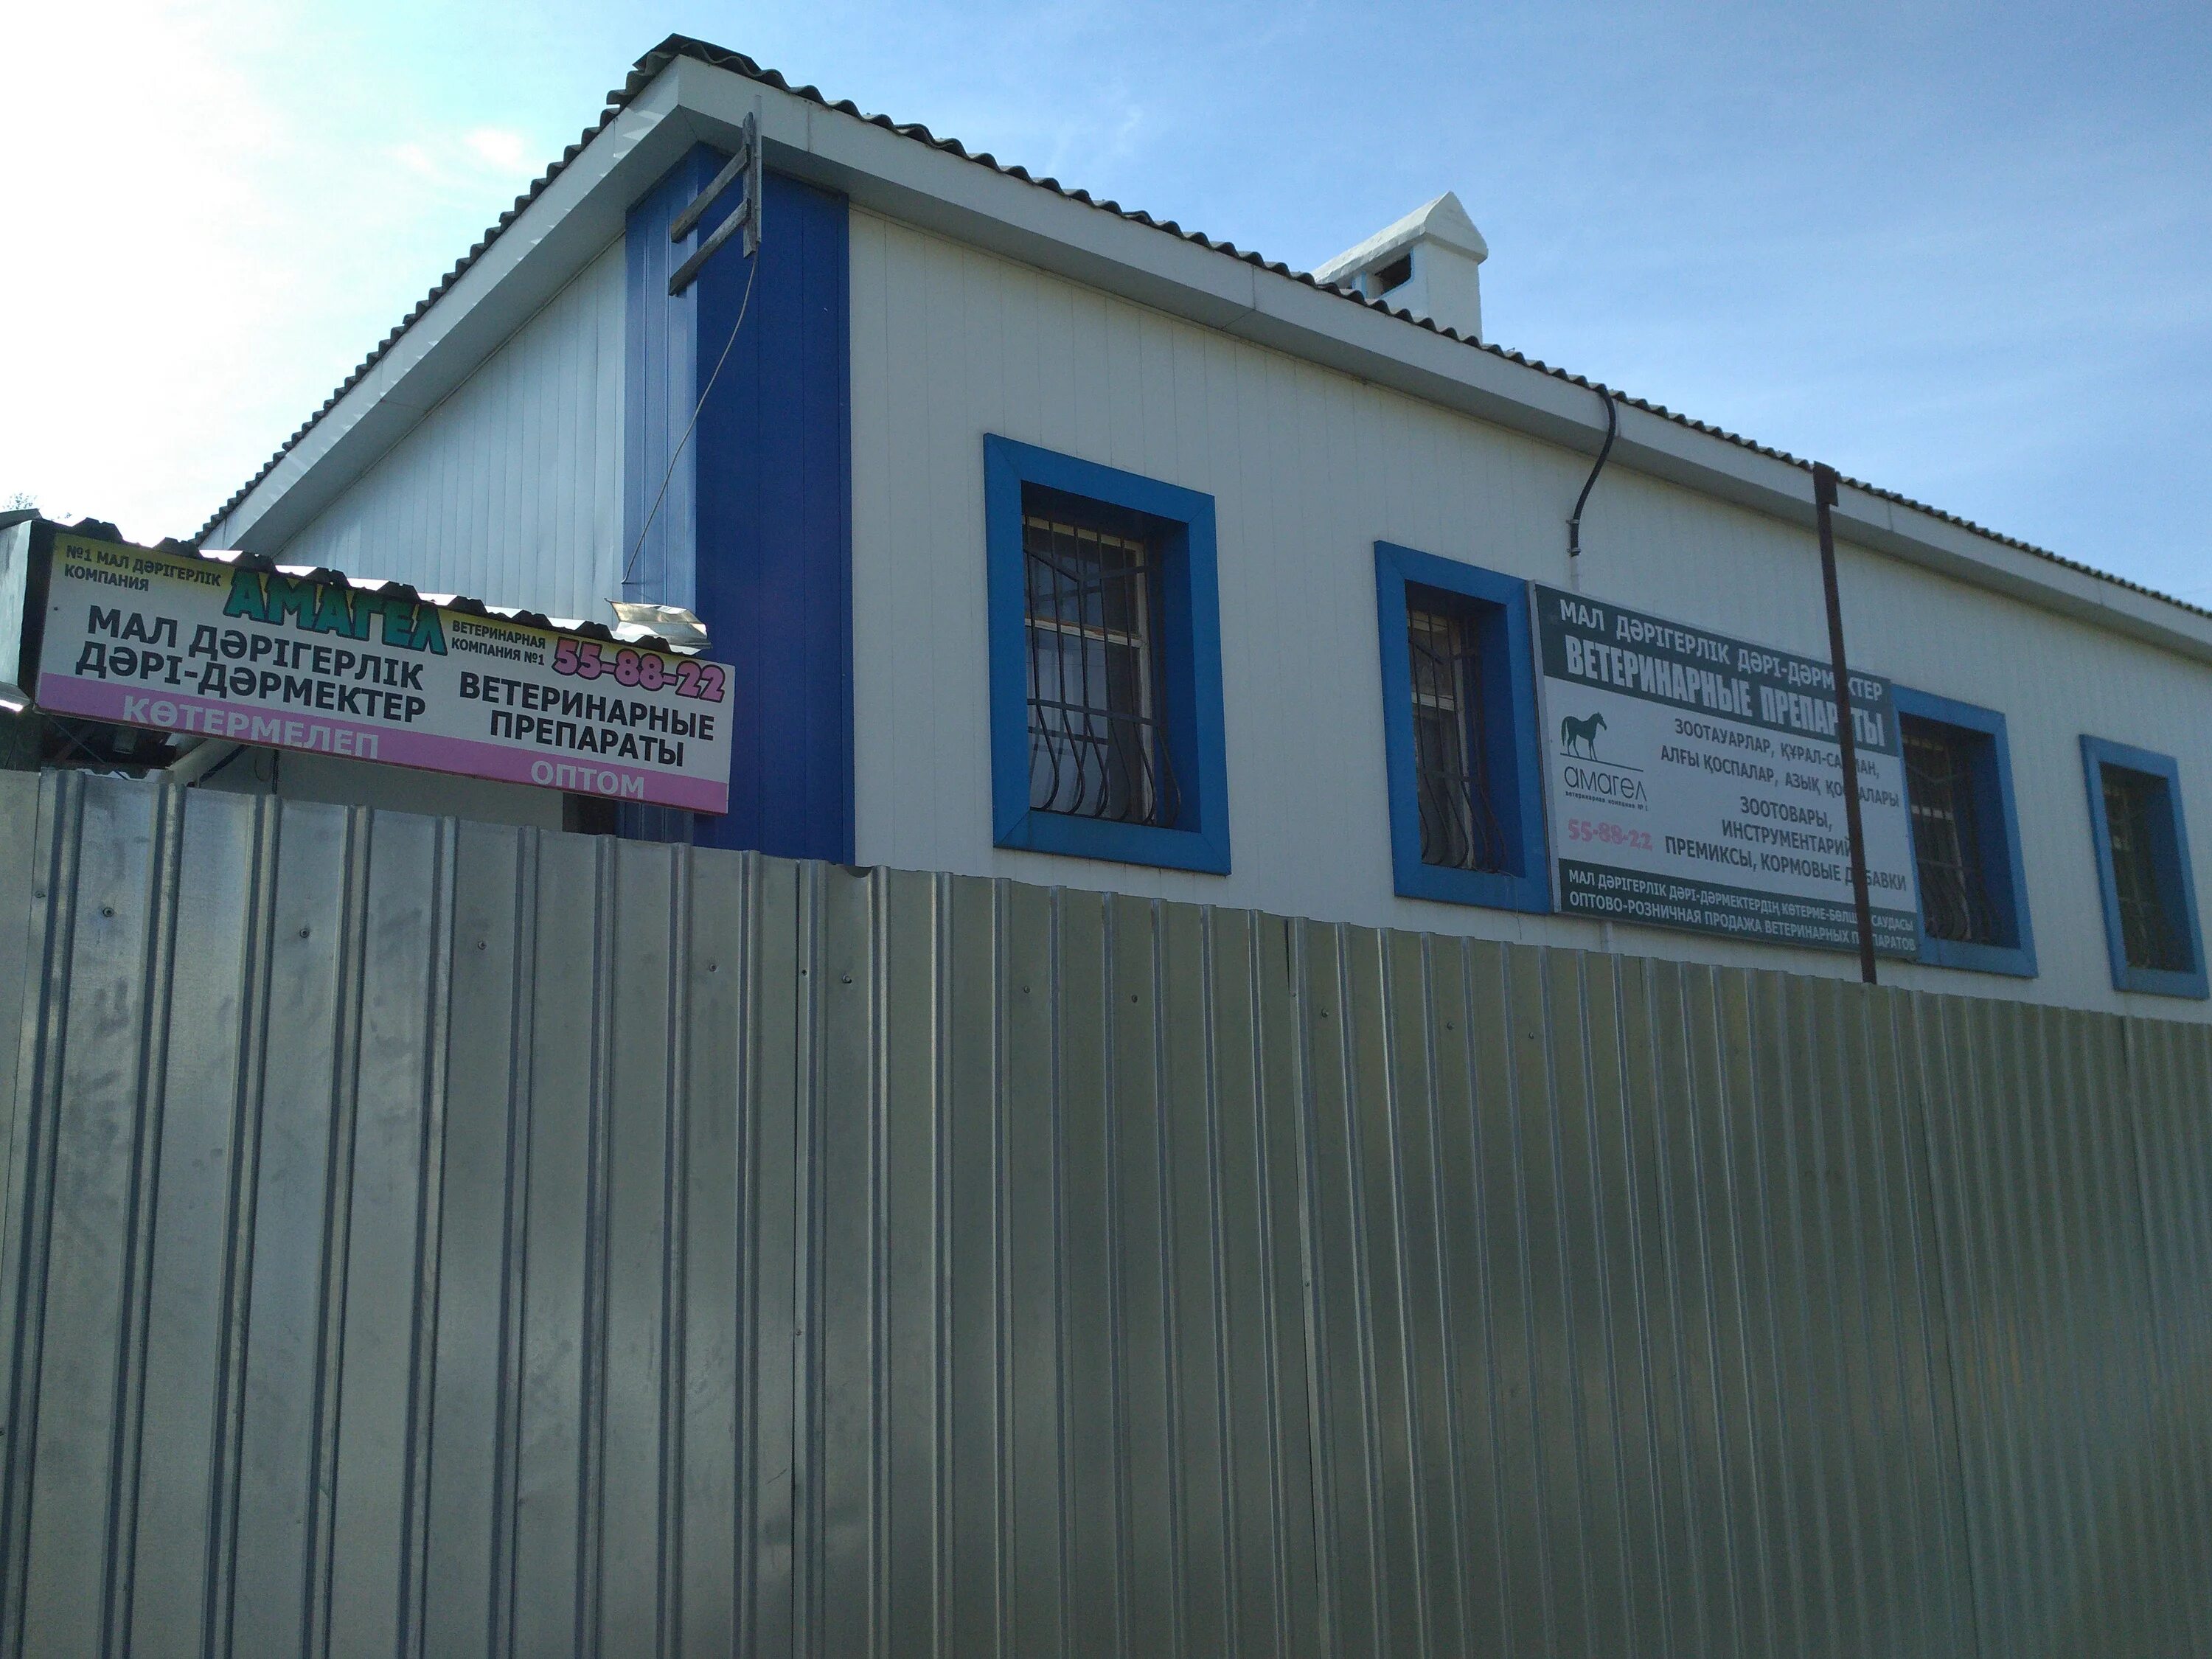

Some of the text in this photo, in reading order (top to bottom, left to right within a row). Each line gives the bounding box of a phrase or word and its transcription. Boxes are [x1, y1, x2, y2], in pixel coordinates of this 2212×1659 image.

[65, 563, 149, 592] КОМПАНИЯ
[97, 551, 128, 569] МАЛ
[133, 556, 221, 587] ДӘРІГЕРЛІК
[223, 567, 448, 656] АМАГЕЛ
[452, 620, 546, 650] ВЕТЕРИНАРНАЯ
[88, 605, 424, 691] МАЛ ДӘРІГЕРЛІК
[451, 636, 545, 666] КОМПАНИЯ №1
[552, 636, 726, 703] 55-88-22
[1559, 599, 1882, 701] МАЛ ДӘРІГЕРЛІК ДӘРІ-ДӘРМКТЕР
[75, 641, 426, 723] ДӘРІ-ДӘРМЕКТЕР
[459, 671, 714, 741] ВЕТЕРИНАРНЫЕ
[1565, 634, 1885, 746] ВЕТЕРИНАРНЫЕ ПРЕПАРТЫ
[123, 695, 379, 759] КӨТЕРМЕЛЕП
[490, 710, 684, 767] ПРЕПАРАТЫ
[1674, 718, 1775, 758] ЗООТАУАРЛАР,
[531, 760, 644, 800] ОПТОМ
[1704, 751, 1778, 787] ҚОСПАЛАР,
[1826, 779, 1899, 807] ҚОАЛАРЫ
[1740, 796, 1833, 832] ЗООТОВАРЫ,
[1665, 835, 1907, 891] ПРЕМИКСЫ, КОРМОВЫЕ ДБАВКИ
[1568, 869, 1595, 886] МАЛ
[1599, 874, 1667, 897] ДӘРІГЕРЛІК
[1871, 914, 1914, 932] САУДАСЫ
[1569, 891, 1701, 924] ОПТОВО-РОЗНИЧНАЯ
[1705, 911, 1762, 932] ПРОДАЖА
[1765, 920, 1850, 944] ВЕТЕРИНАРНЫХ
